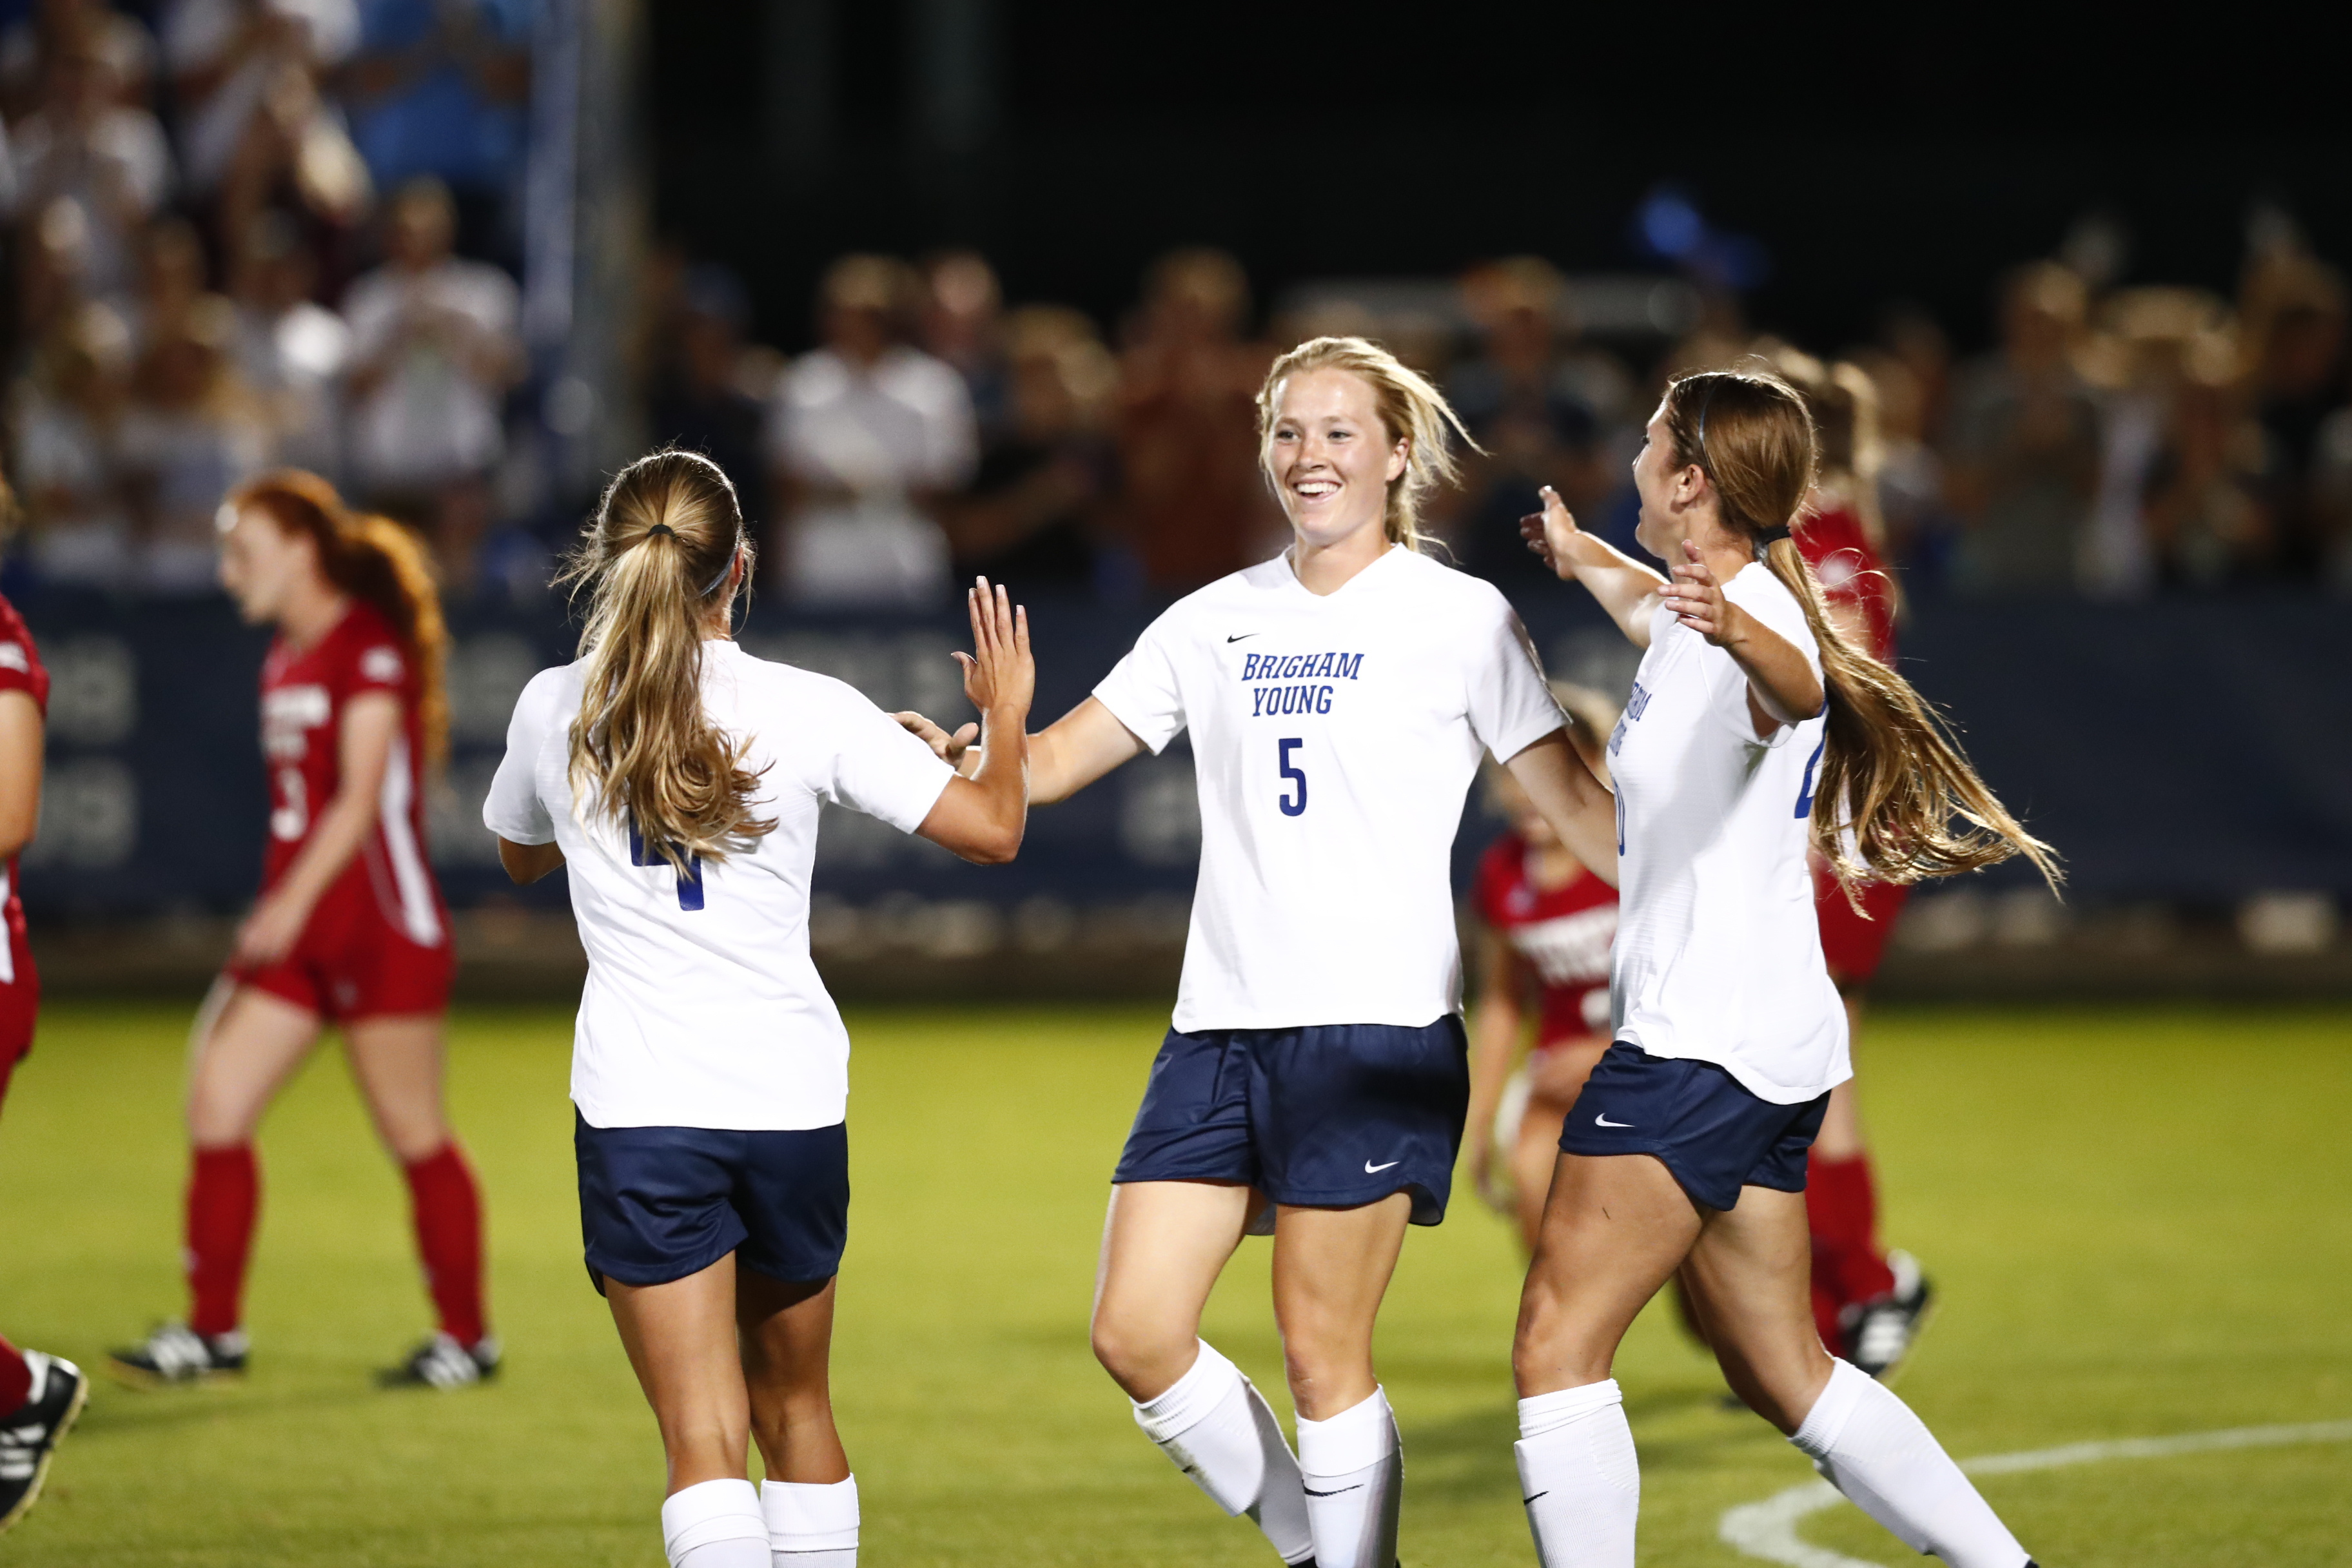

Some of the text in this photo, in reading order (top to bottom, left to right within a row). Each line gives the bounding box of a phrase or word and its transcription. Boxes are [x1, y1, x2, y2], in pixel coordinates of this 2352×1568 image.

[1241, 652, 1365, 681] BRIGHAM
[1252, 685, 1334, 717] YOUNG
[1279, 738, 1307, 817] 5
